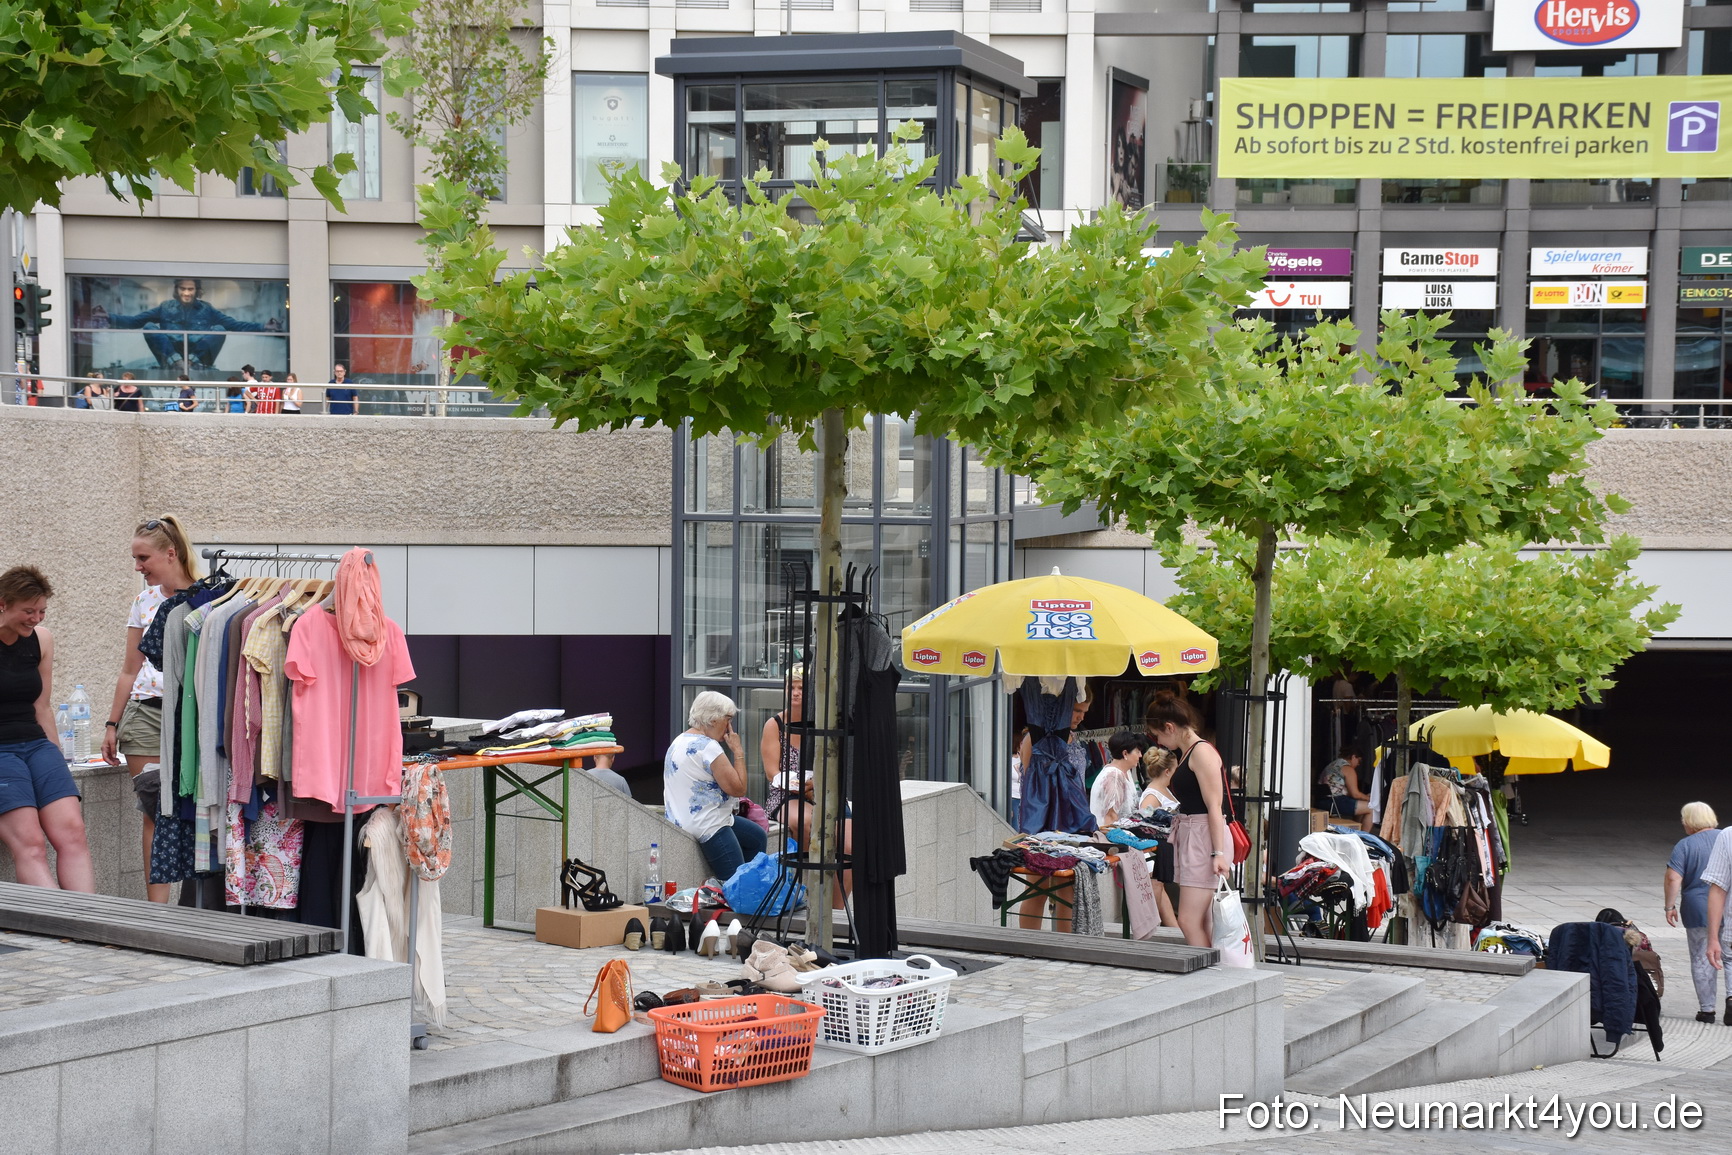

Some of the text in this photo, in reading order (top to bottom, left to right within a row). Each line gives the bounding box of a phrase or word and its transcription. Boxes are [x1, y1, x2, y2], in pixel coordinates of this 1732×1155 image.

[1546, 0, 1631, 33] Hervis
[1552, 28, 1593, 36] SPORTS
[1236, 101, 1651, 129] SHOPPEN = FREIPARKEN
[1681, 116, 1707, 147] P
[1234, 135, 1649, 158] Ab sofort bis zu 2 Std. kostenfrei parken
[1267, 256, 1323, 269] Vögele
[1400, 251, 1480, 268] GameStop
[1544, 250, 1623, 265] Spielwaren
[1591, 263, 1635, 274] Krömer
[1425, 284, 1453, 294] LUISA
[1299, 294, 1322, 306] TUI
[1425, 297, 1453, 307] LUISA
[1031, 611, 1093, 626] Ice
[1027, 625, 1098, 640] Tea
[915, 653, 938, 661] Lipton
[965, 656, 984, 664] Lipton
[1141, 656, 1158, 664] Lipton
[1183, 653, 1204, 661] Lipton
